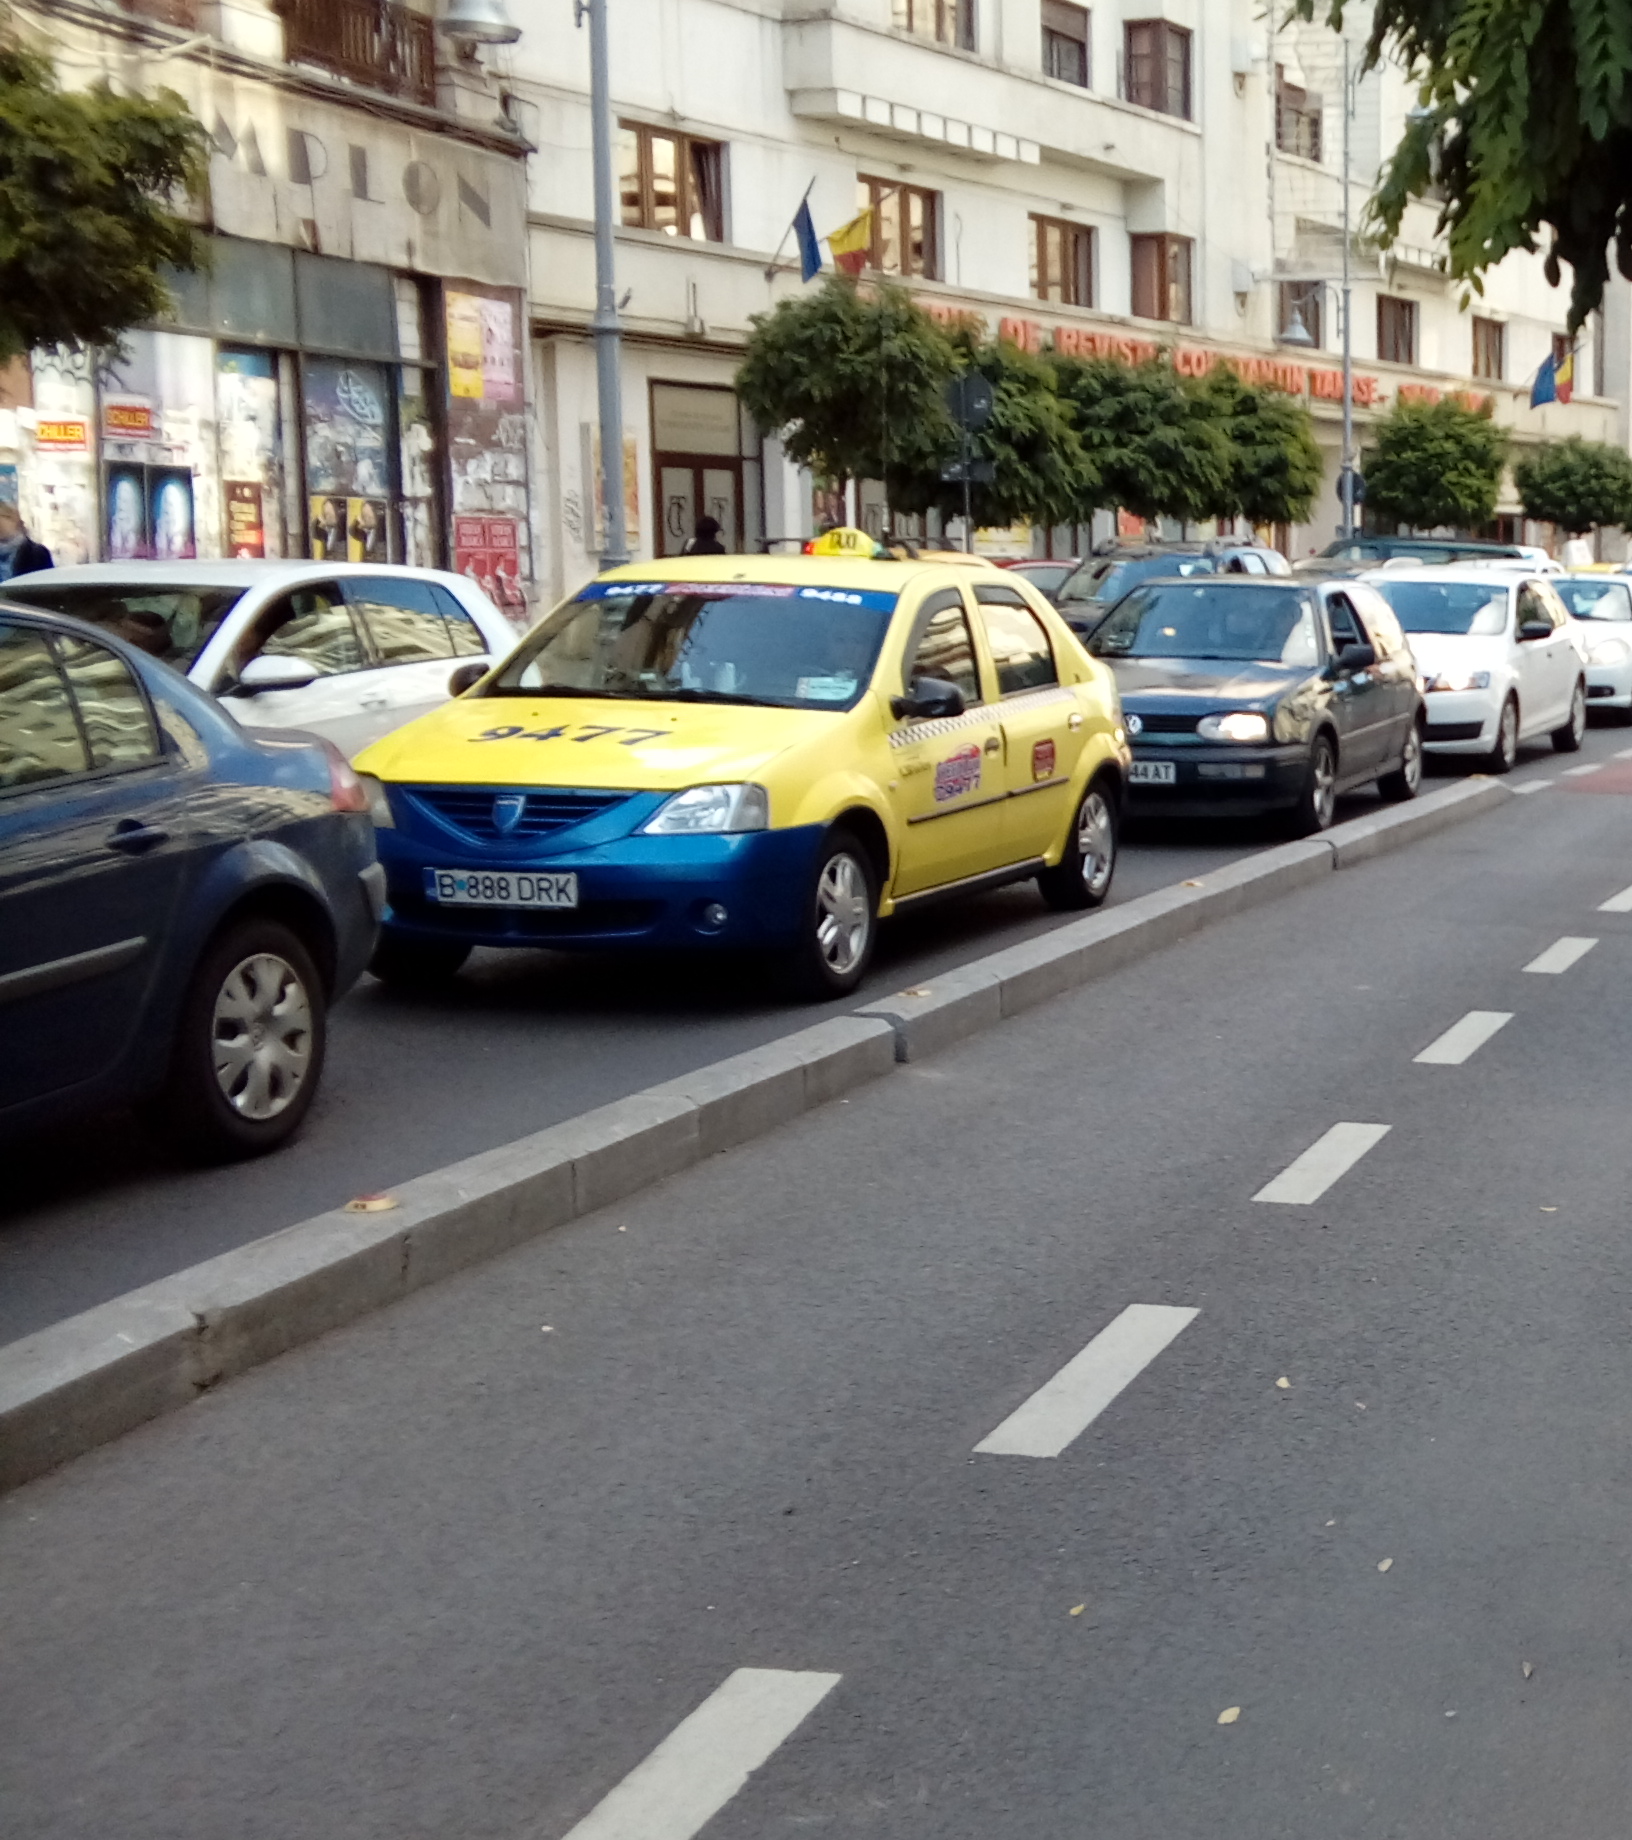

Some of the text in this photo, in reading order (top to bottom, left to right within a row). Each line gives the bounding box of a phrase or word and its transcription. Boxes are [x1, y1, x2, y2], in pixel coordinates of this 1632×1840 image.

[467, 724, 673, 746] 9477
[1151, 763, 1171, 780] AT
[438, 874, 573, 902] B 888 DRK
